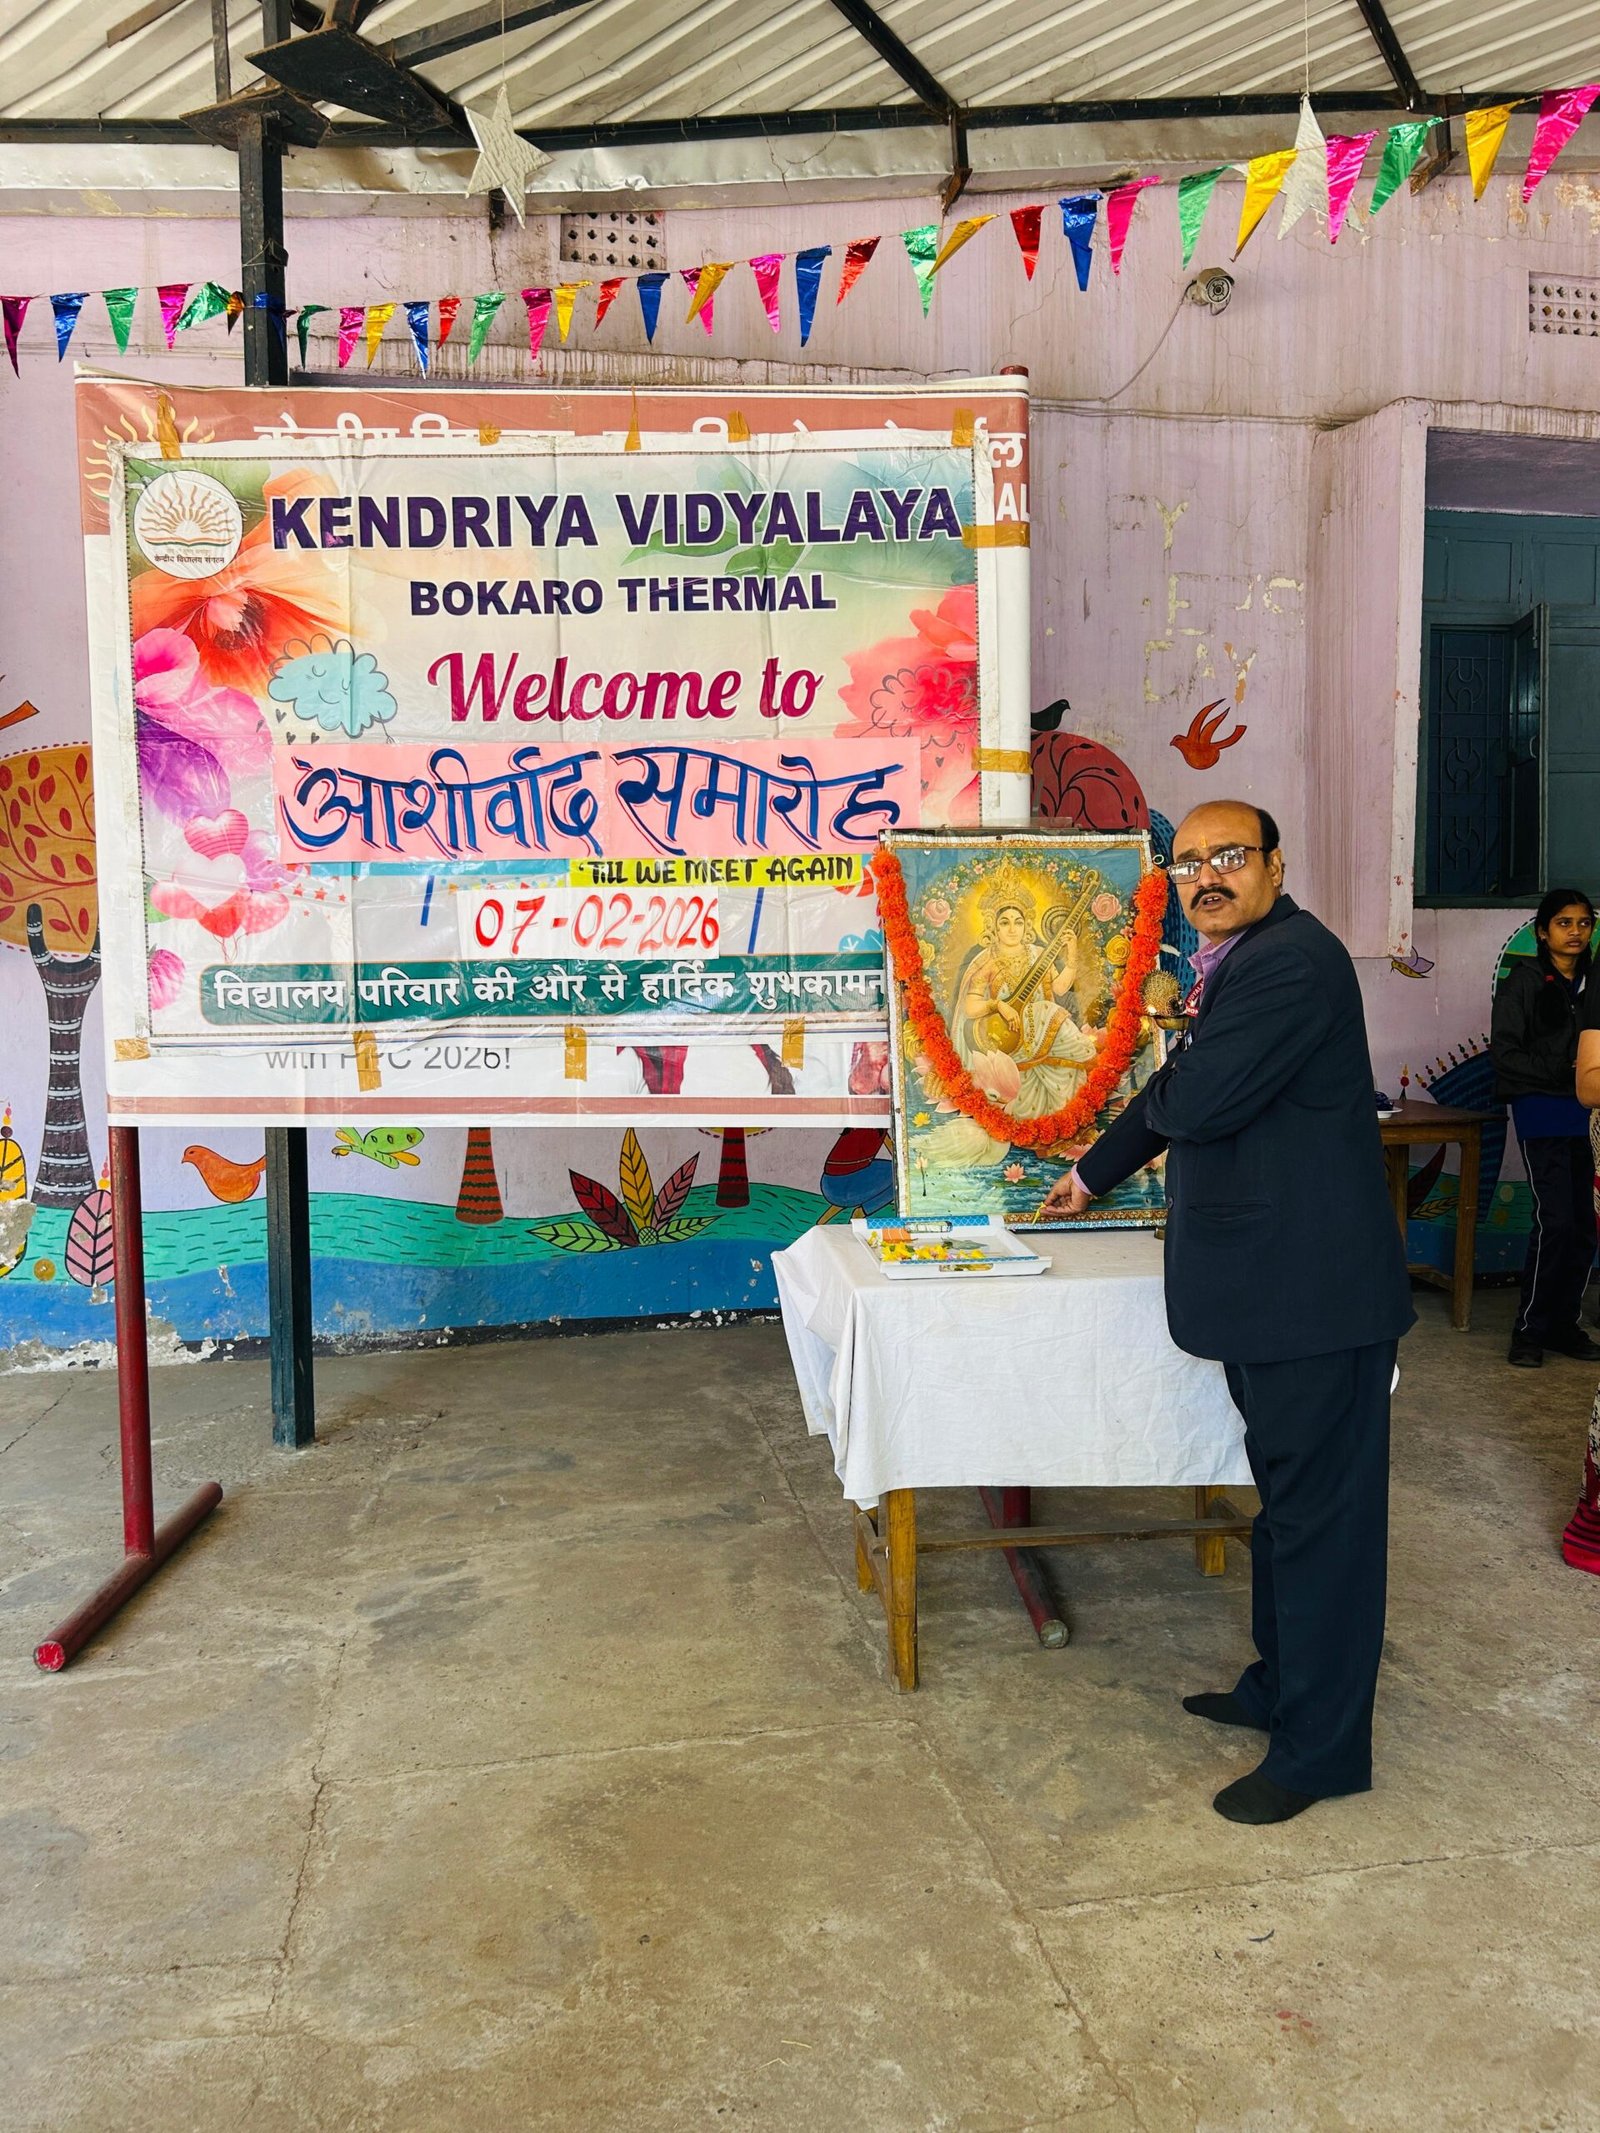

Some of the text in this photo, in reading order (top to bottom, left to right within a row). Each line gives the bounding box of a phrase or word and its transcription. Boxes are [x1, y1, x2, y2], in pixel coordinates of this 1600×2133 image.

[272, 488, 963, 549] KENDRIYA VIDYALAYA
[410, 575, 837, 616] BOKARO THERMAL
[427, 652, 823, 722] Welcome to
[280, 746, 905, 861] आशीर्वाद समारोह
[636, 859, 677, 883] WE
[685, 858, 759, 883] MEET
[766, 856, 853, 882] AGAIN
[214, 970, 346, 1009] विद्यालय
[358, 967, 460, 1008] परिवार
[472, 967, 518, 1002] की
[529, 964, 587, 1000] ओर
[600, 964, 627, 999] से
[640, 961, 735, 1002] हार्दिक
[424, 1046, 510, 1069] 2026!
